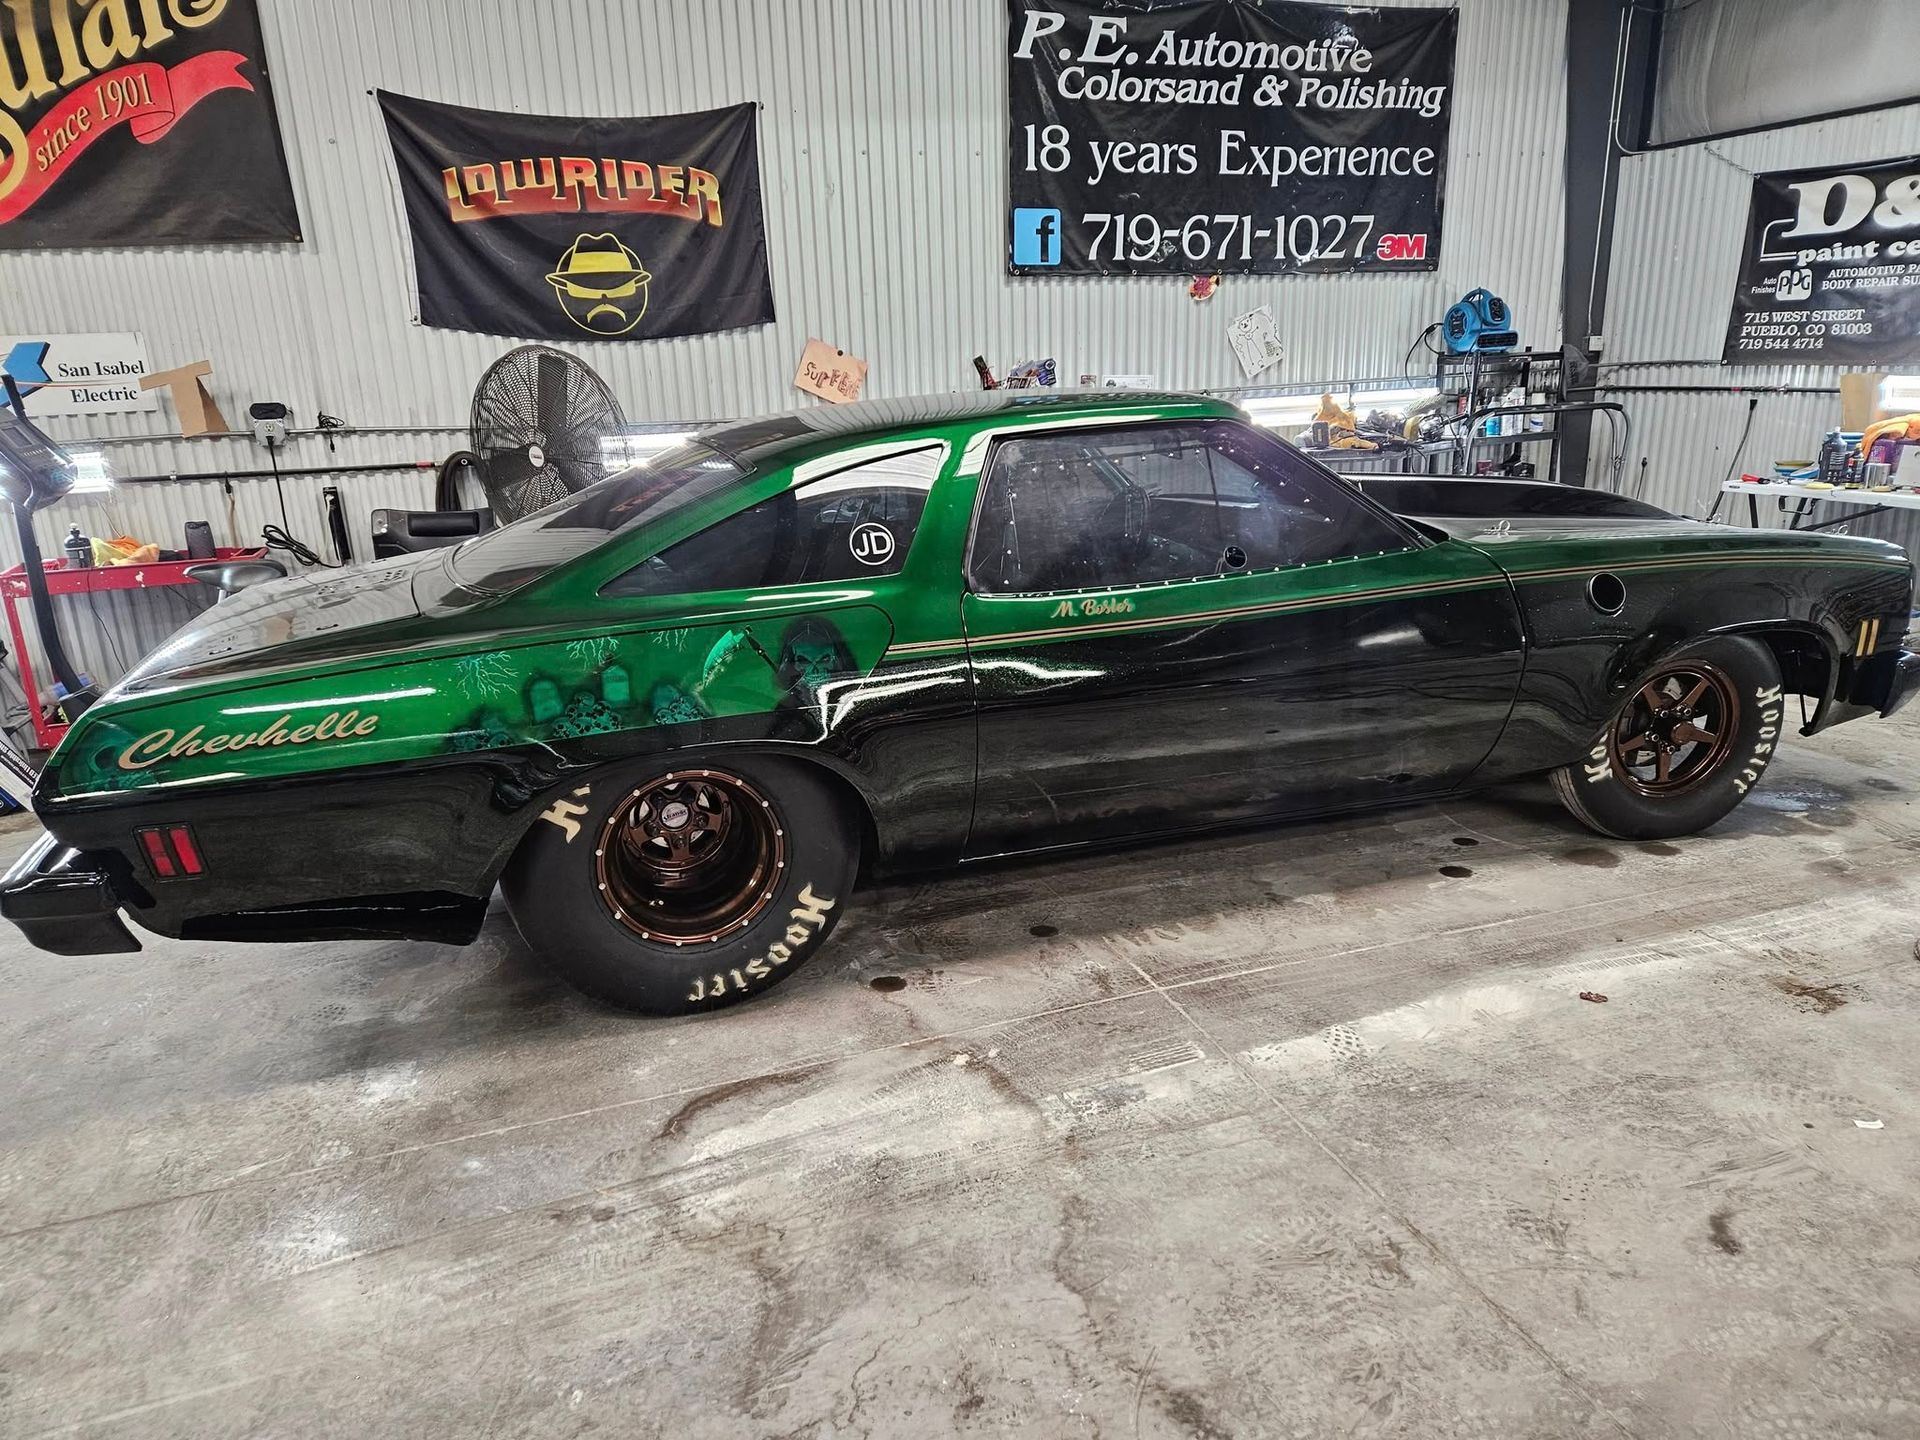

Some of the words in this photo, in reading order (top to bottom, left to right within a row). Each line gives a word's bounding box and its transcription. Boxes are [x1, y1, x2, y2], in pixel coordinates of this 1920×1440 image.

[1013, 9, 1139, 66] P.E.
[1147, 30, 1373, 74] Automotive
[1057, 66, 1243, 106] Colorsand
[1253, 75, 1289, 107] &
[1295, 78, 1446, 118] Polishing
[35, 106, 90, 172] since
[95, 73, 154, 121] 1901
[1024, 124, 1071, 172] 18
[1087, 140, 1198, 186] years
[1218, 130, 1435, 187] Experience
[442, 156, 723, 228] LOWRIDER
[1082, 213, 1376, 262] 719-671-1027
[1377, 233, 1427, 261] 3M
[1796, 240, 1880, 267] paint
[1763, 277, 1777, 286] Auto
[1827, 265, 1906, 279] AUTOMOTIVE
[1751, 286, 1776, 295] Finishes
[1821, 279, 1853, 291] BODY
[1855, 277, 1899, 289] REPAIR
[1744, 311, 1769, 324] 715
[1771, 310, 1810, 323] WEST
[1811, 308, 1865, 322] STREET
[1740, 325, 1801, 338] PUEBLO,
[1805, 324, 1826, 337] CO
[1830, 323, 1873, 336] 81003
[1739, 338, 1764, 351] 719
[1763, 338, 1792, 350] 544
[1791, 336, 1824, 350] 4714
[58, 363, 92, 379] San
[95, 360, 146, 377] Isabel
[71, 386, 138, 404] Electric
[855, 530, 892, 557] JD
[117, 709, 380, 771] Chevhelle
